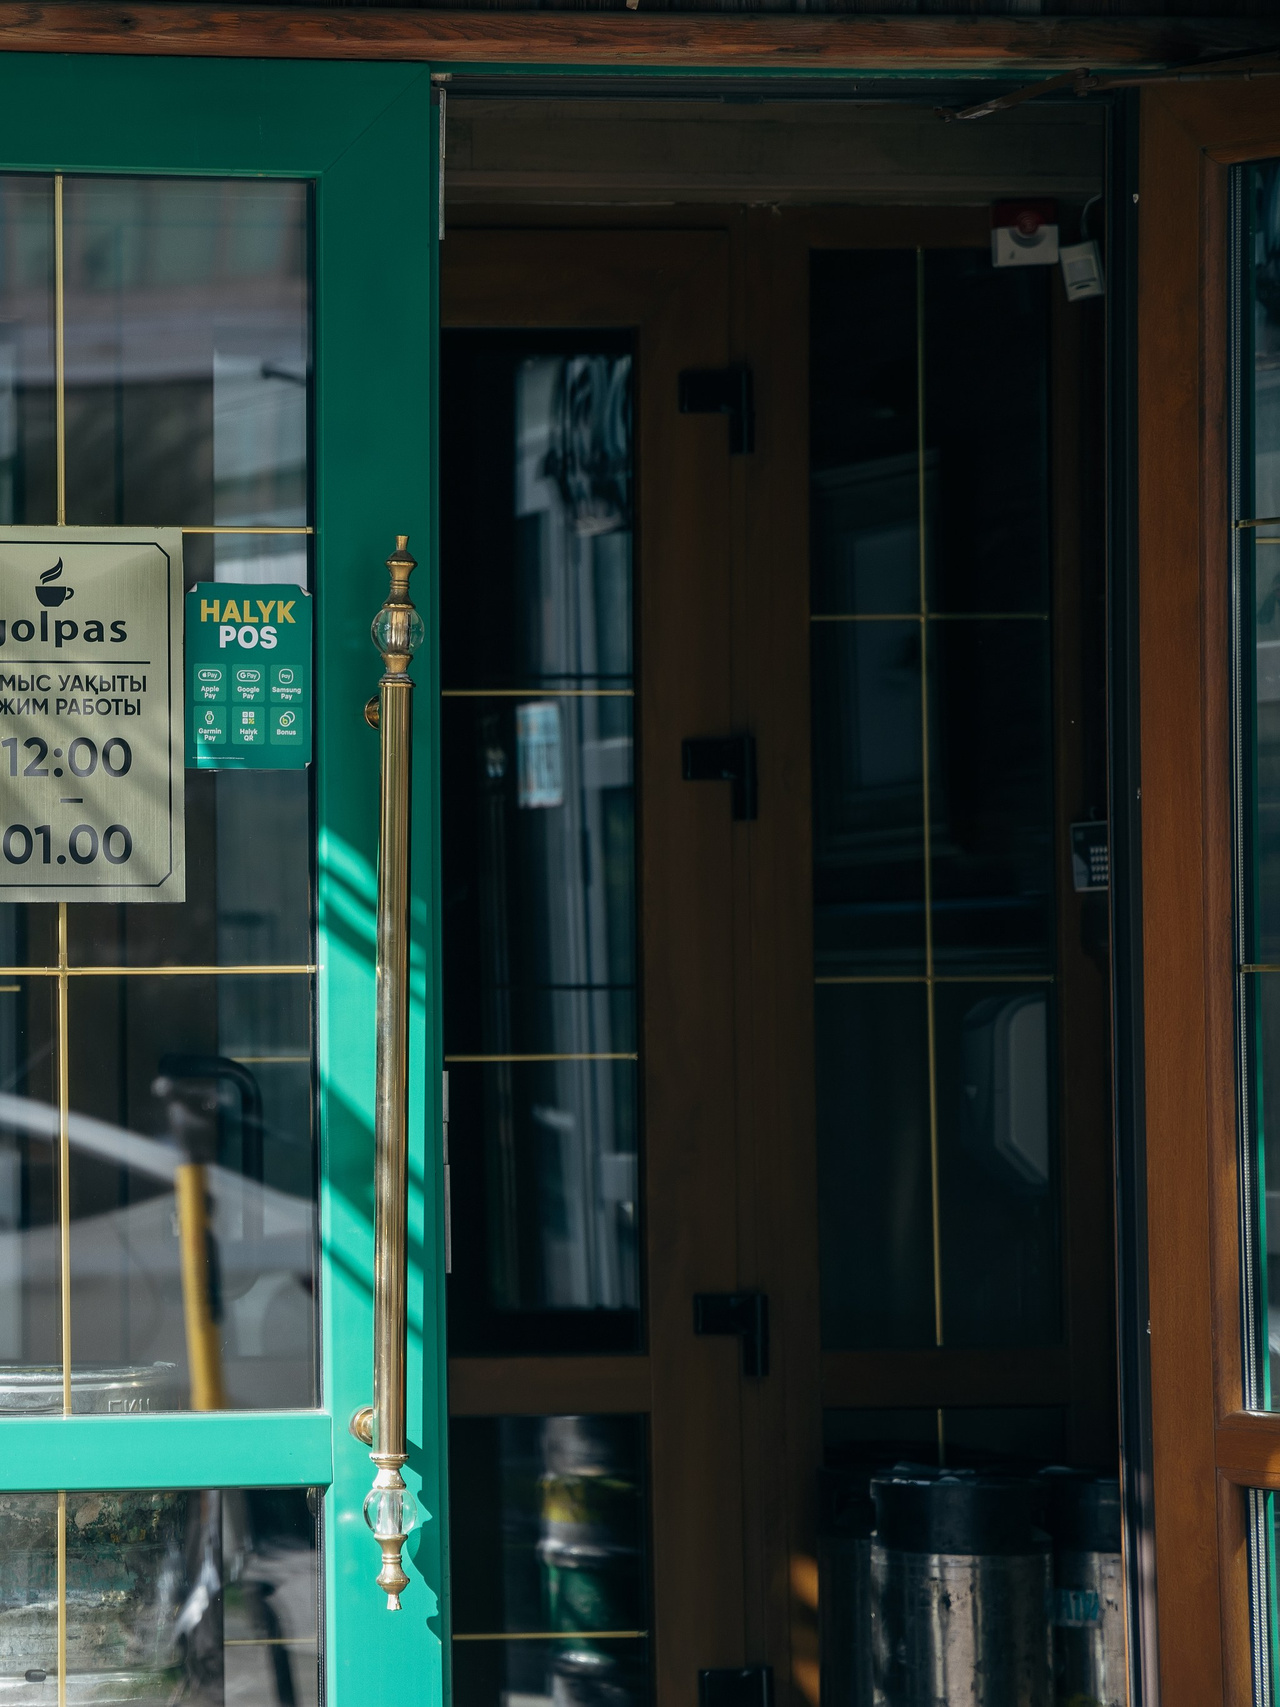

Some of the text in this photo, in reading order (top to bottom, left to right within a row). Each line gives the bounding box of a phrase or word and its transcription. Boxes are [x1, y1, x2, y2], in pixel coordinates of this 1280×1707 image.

[200, 599, 297, 624] HALYK
[219, 625, 278, 650] POS
[58, 674, 147, 695] УАҚЫТЫ
[201, 685, 220, 693] Apple
[272, 686, 301, 694] Samsung
[56, 698, 141, 716] РАБОТЫ
[239, 728, 258, 736] Halyk
[1, 737, 133, 778] 12:00
[2, 823, 133, 865] 01.00
